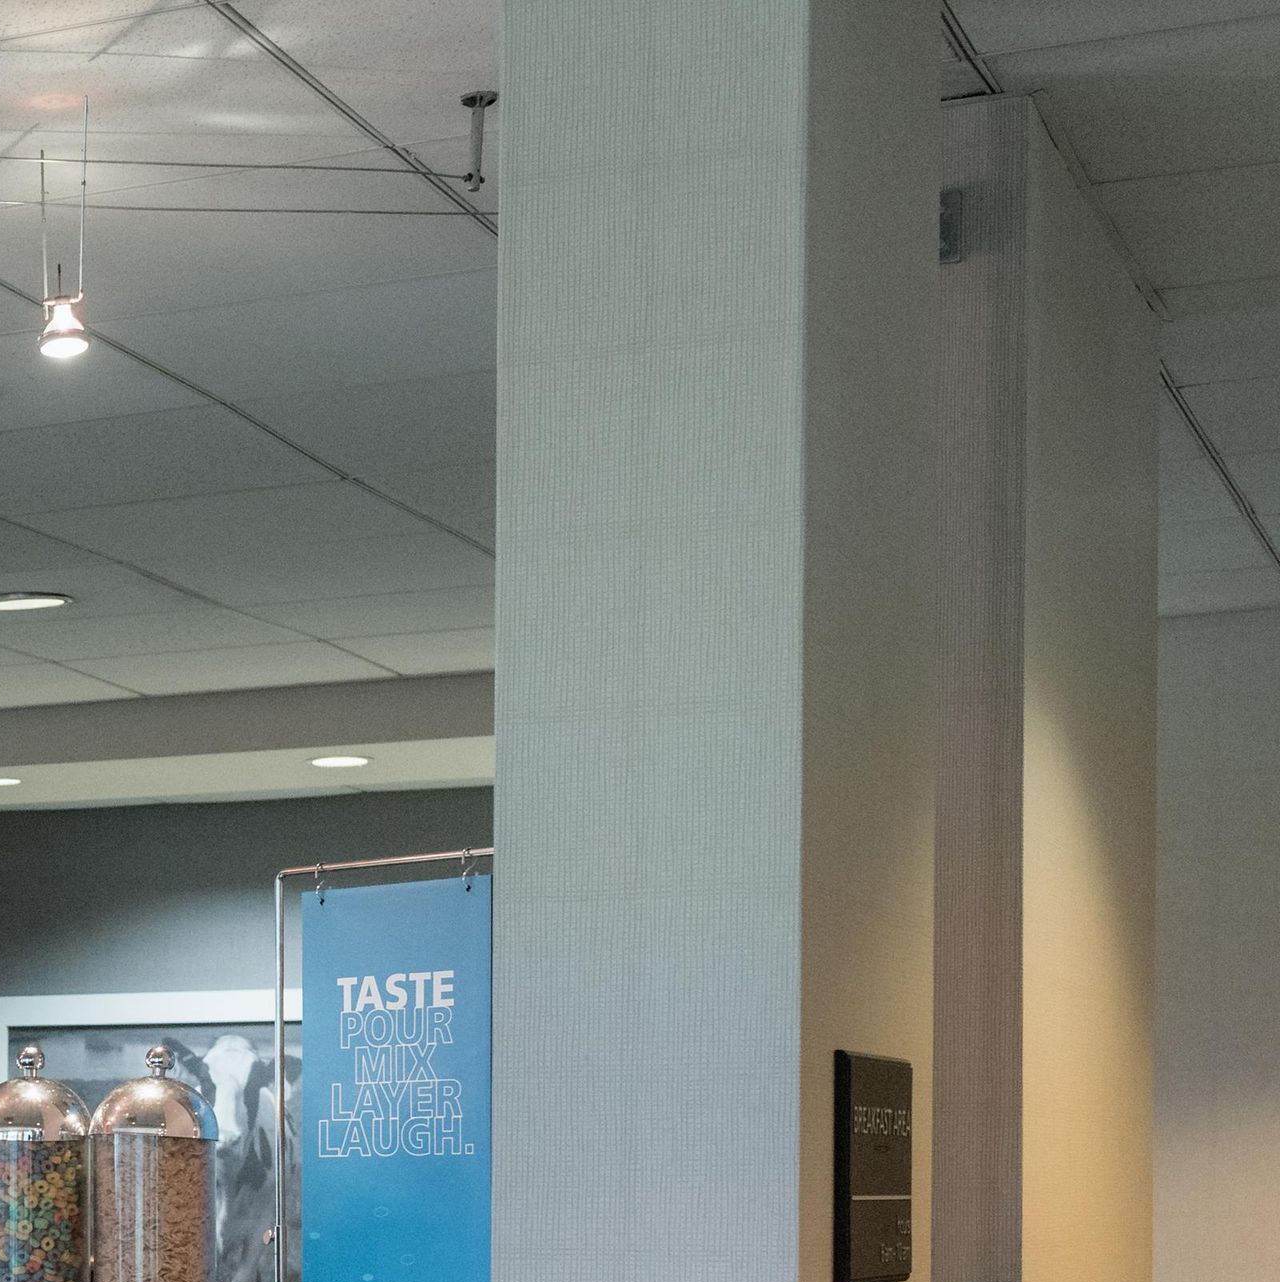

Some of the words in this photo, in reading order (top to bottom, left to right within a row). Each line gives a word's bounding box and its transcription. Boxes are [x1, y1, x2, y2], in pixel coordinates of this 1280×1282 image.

[337, 970, 454, 1012] TASTE
[340, 1006, 453, 1049] POUR
[355, 1043, 437, 1084] MIX
[331, 1079, 463, 1121] LAYER
[318, 1116, 474, 1157] LAUGH.
